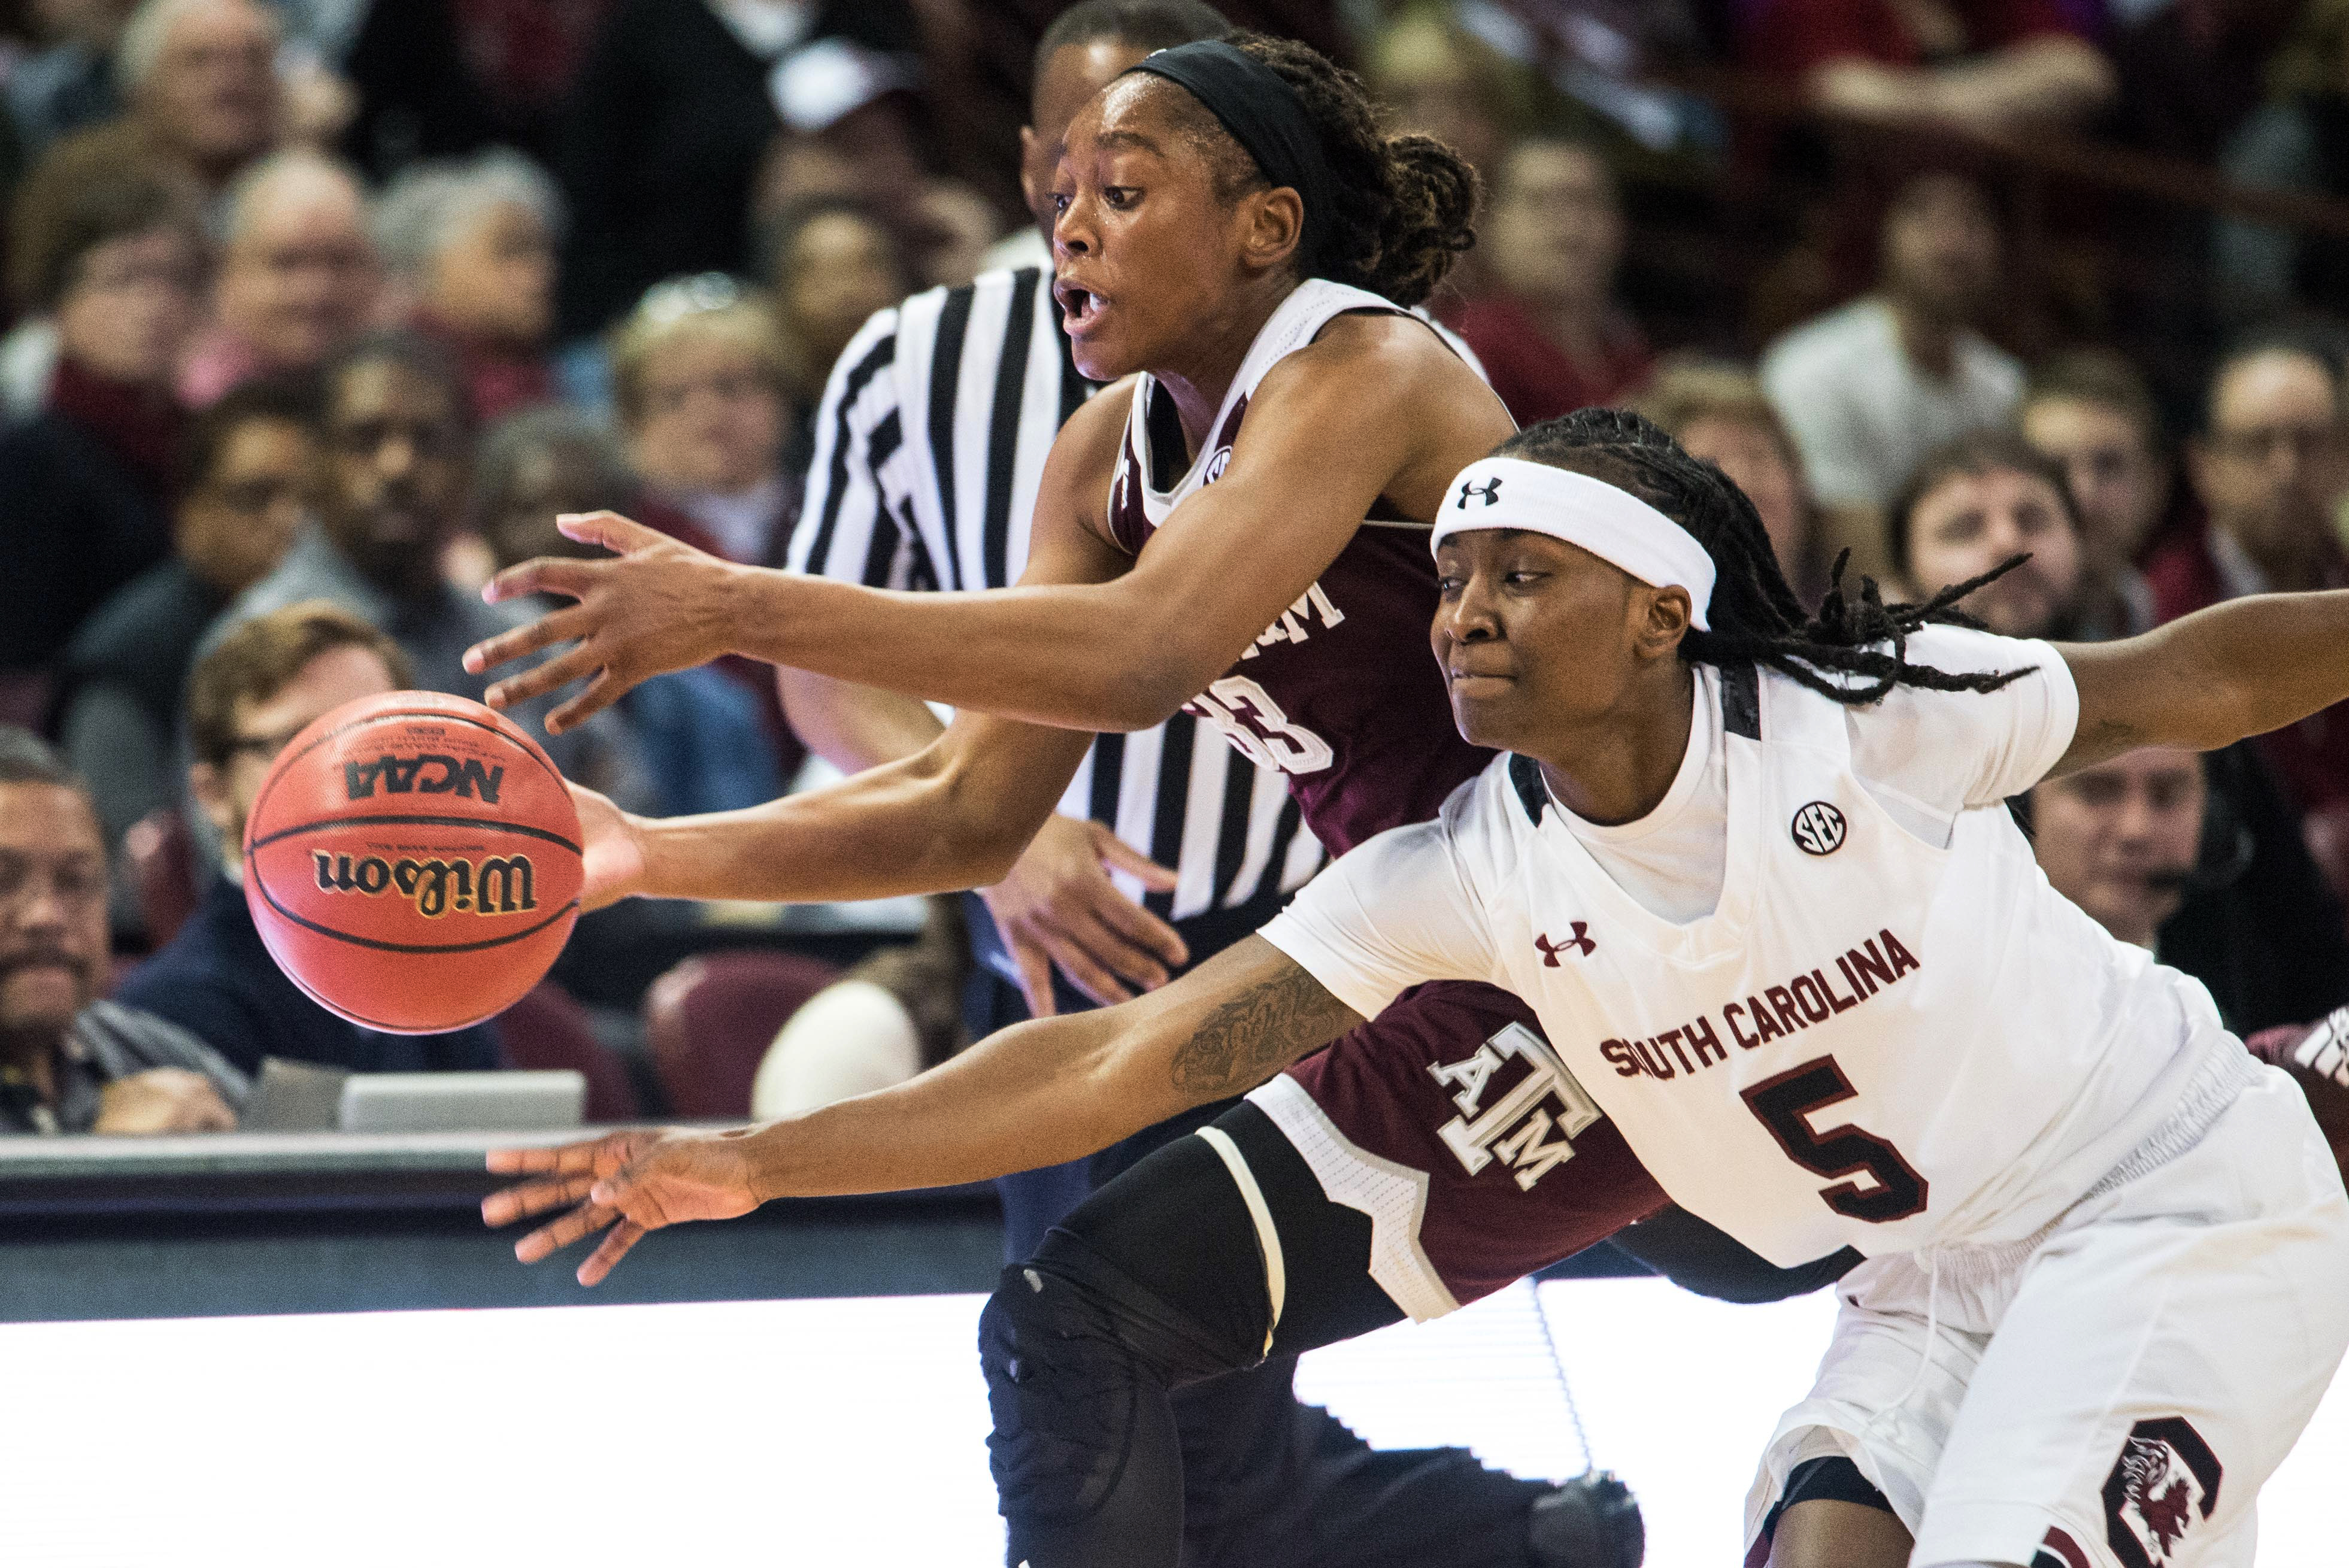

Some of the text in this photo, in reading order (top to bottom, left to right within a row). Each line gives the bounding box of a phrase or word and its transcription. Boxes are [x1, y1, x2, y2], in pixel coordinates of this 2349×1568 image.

[345, 754, 504, 804] NCAA
[1796, 803, 1844, 853] SEC
[312, 850, 537, 918] Wilson
[1723, 929, 1920, 1050] CAROLINA
[1738, 1053, 1929, 1224] 5
